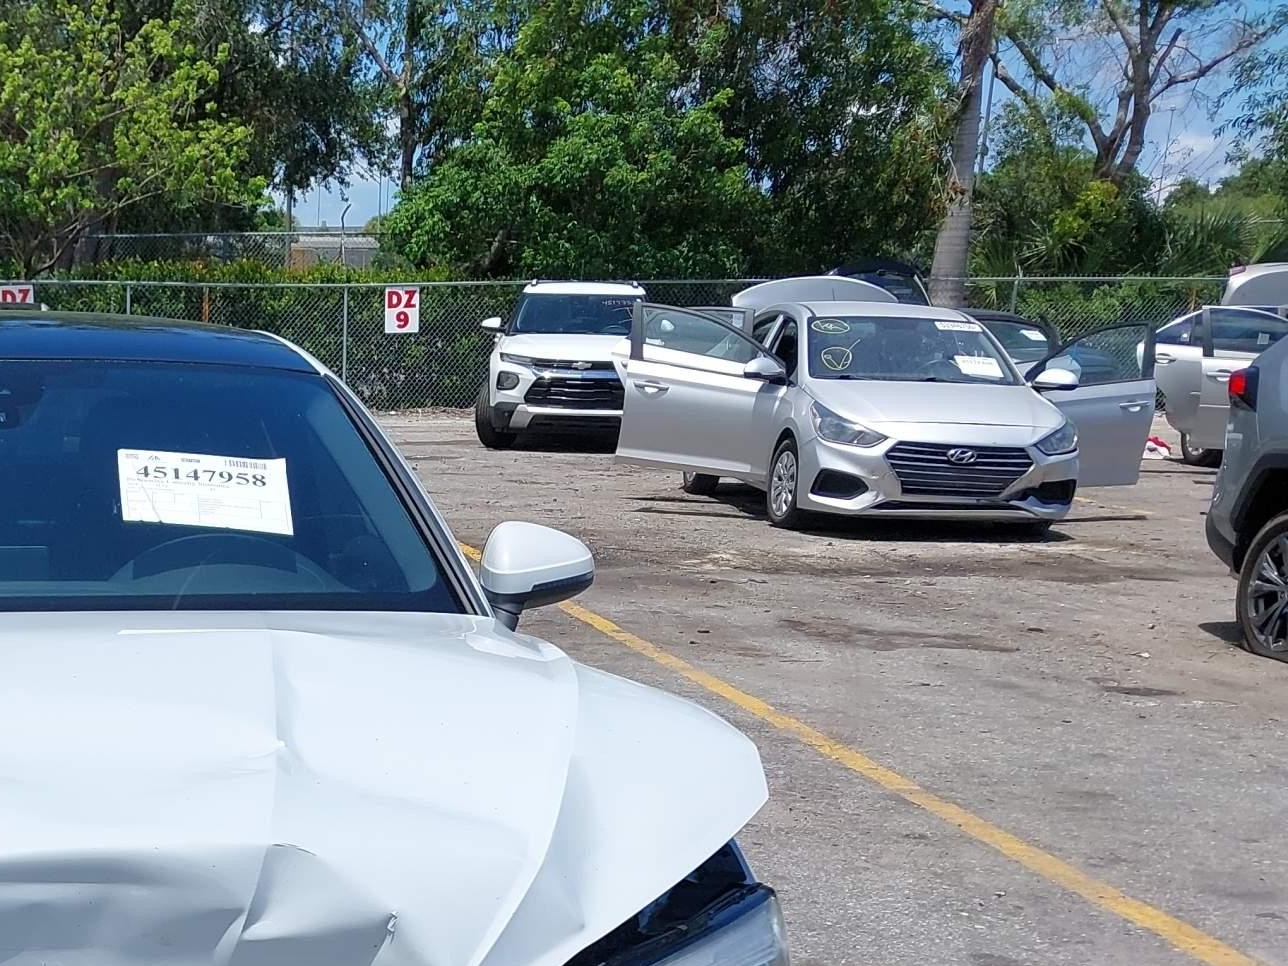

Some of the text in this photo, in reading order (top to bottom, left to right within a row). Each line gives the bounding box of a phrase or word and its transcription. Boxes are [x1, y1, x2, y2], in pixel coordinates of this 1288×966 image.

[387, 289, 417, 309] DZ
[395, 311, 410, 329] 9
[136, 465, 267, 488] 45147958
